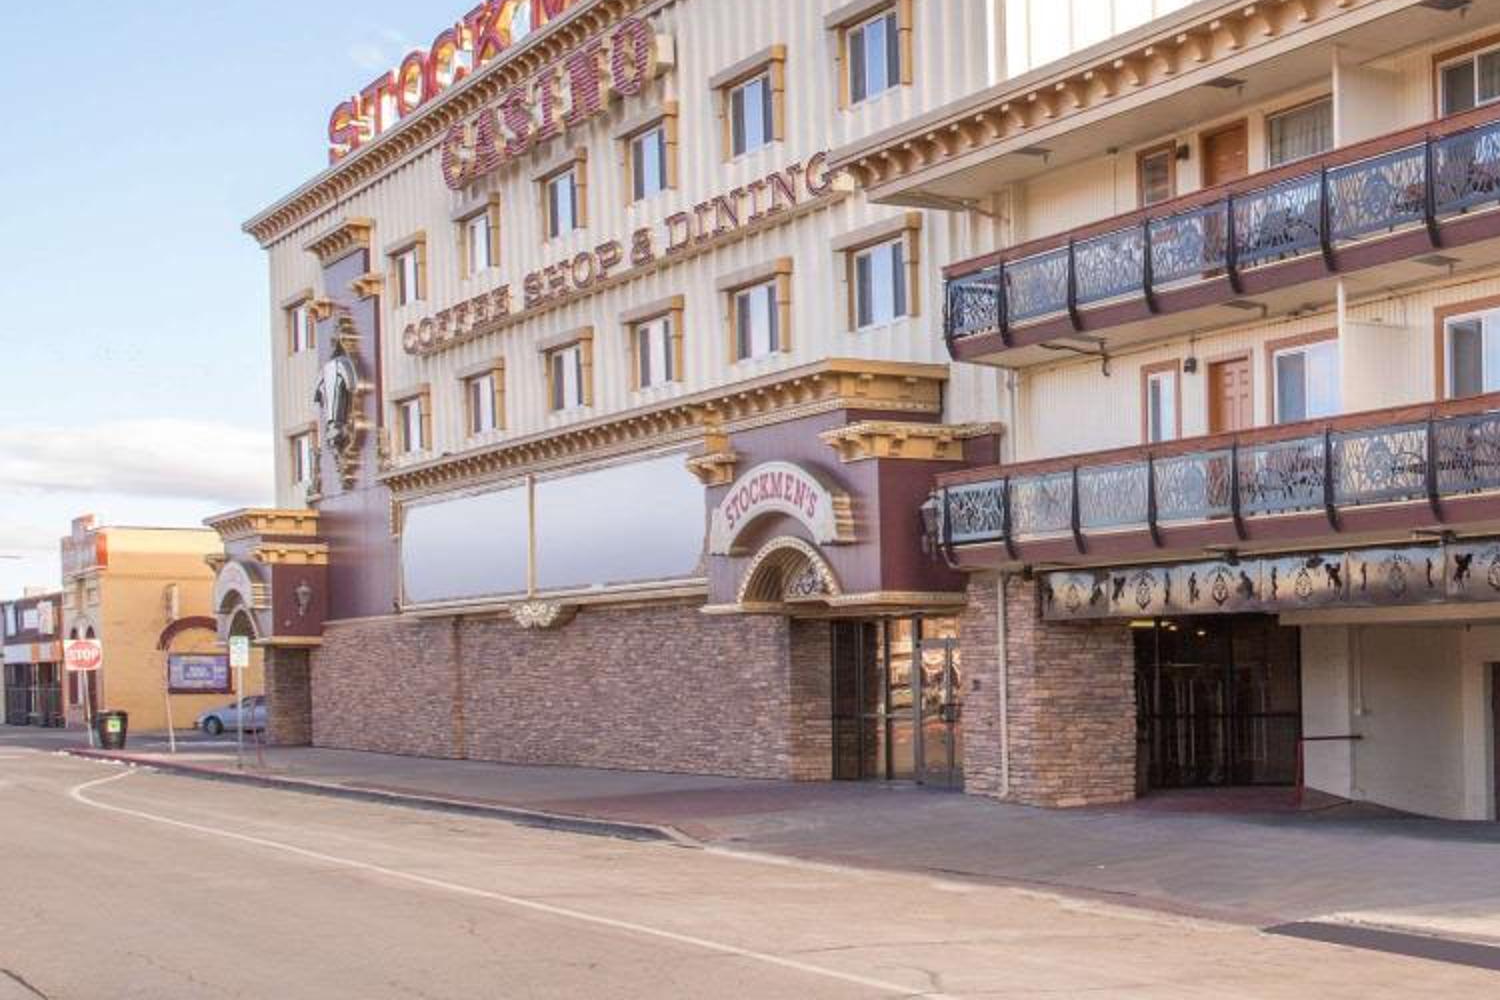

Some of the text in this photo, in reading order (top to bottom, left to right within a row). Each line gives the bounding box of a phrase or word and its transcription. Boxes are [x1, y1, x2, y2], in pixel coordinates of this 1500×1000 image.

[440, 16, 658, 190] CASINO
[402, 151, 832, 355] COFFEE SHOP & DINING
[725, 471, 818, 529] STOCKMEN'S
[65, 647, 99, 663] STOP
